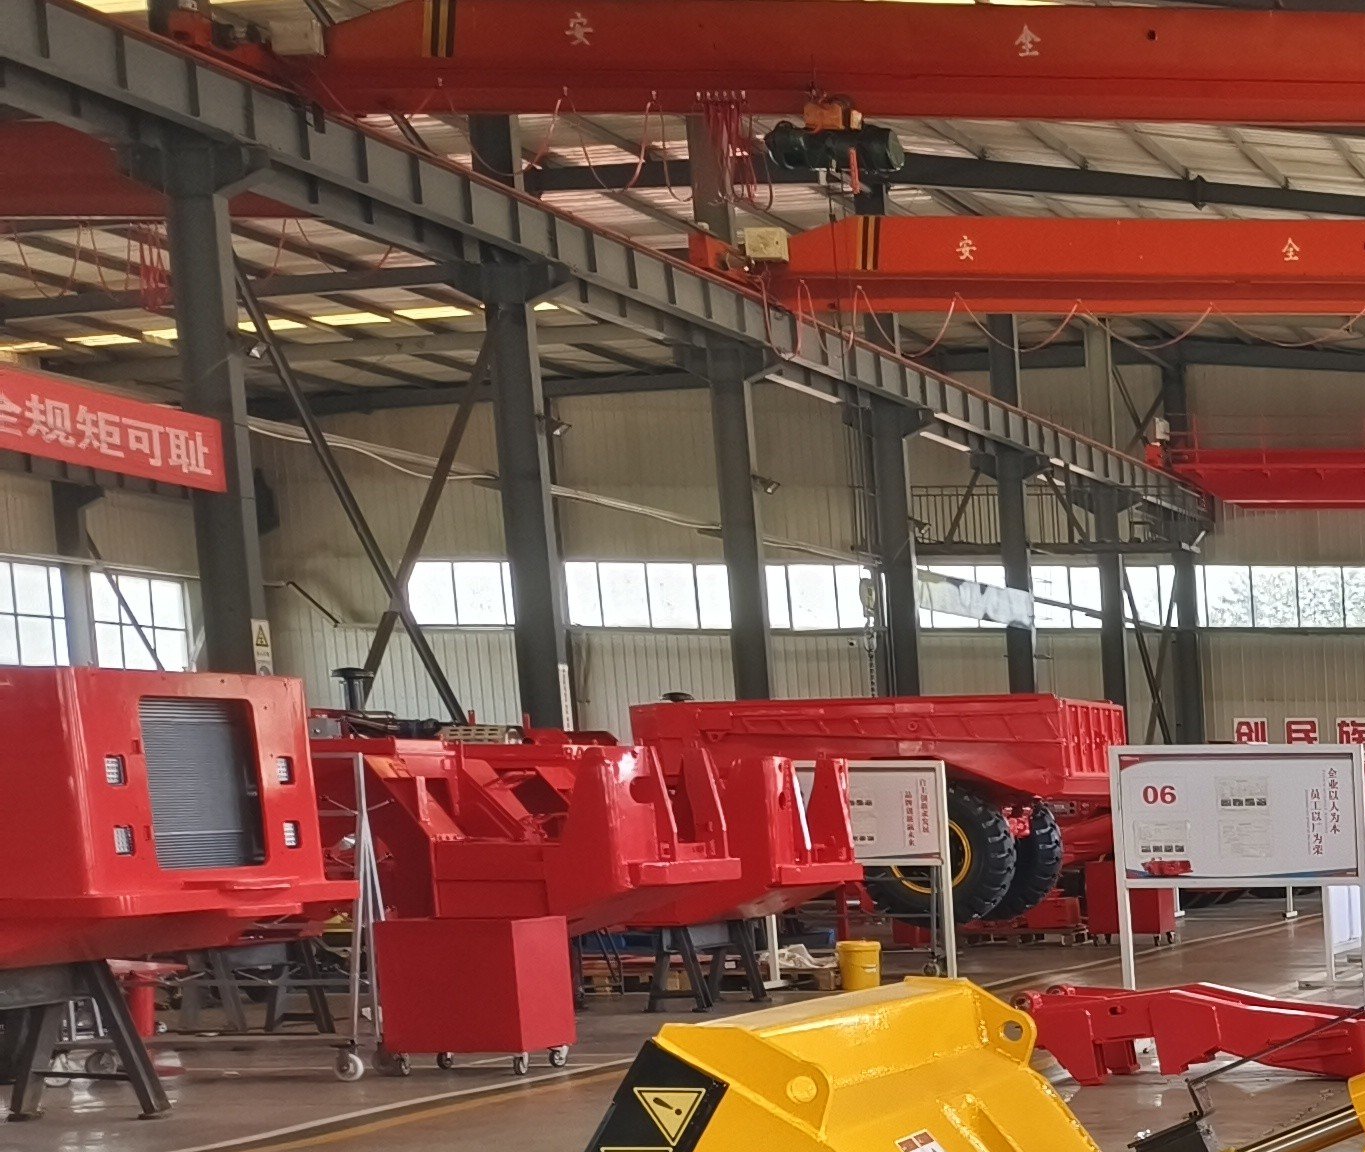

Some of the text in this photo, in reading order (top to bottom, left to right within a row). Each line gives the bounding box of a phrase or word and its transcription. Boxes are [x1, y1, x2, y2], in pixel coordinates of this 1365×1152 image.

[564, 11, 594, 46] 安
[1014, 24, 1042, 57] 全
[955, 235, 978, 261] 安
[1281, 237, 1301, 262] 全
[1142, 785, 1177, 805] 06
